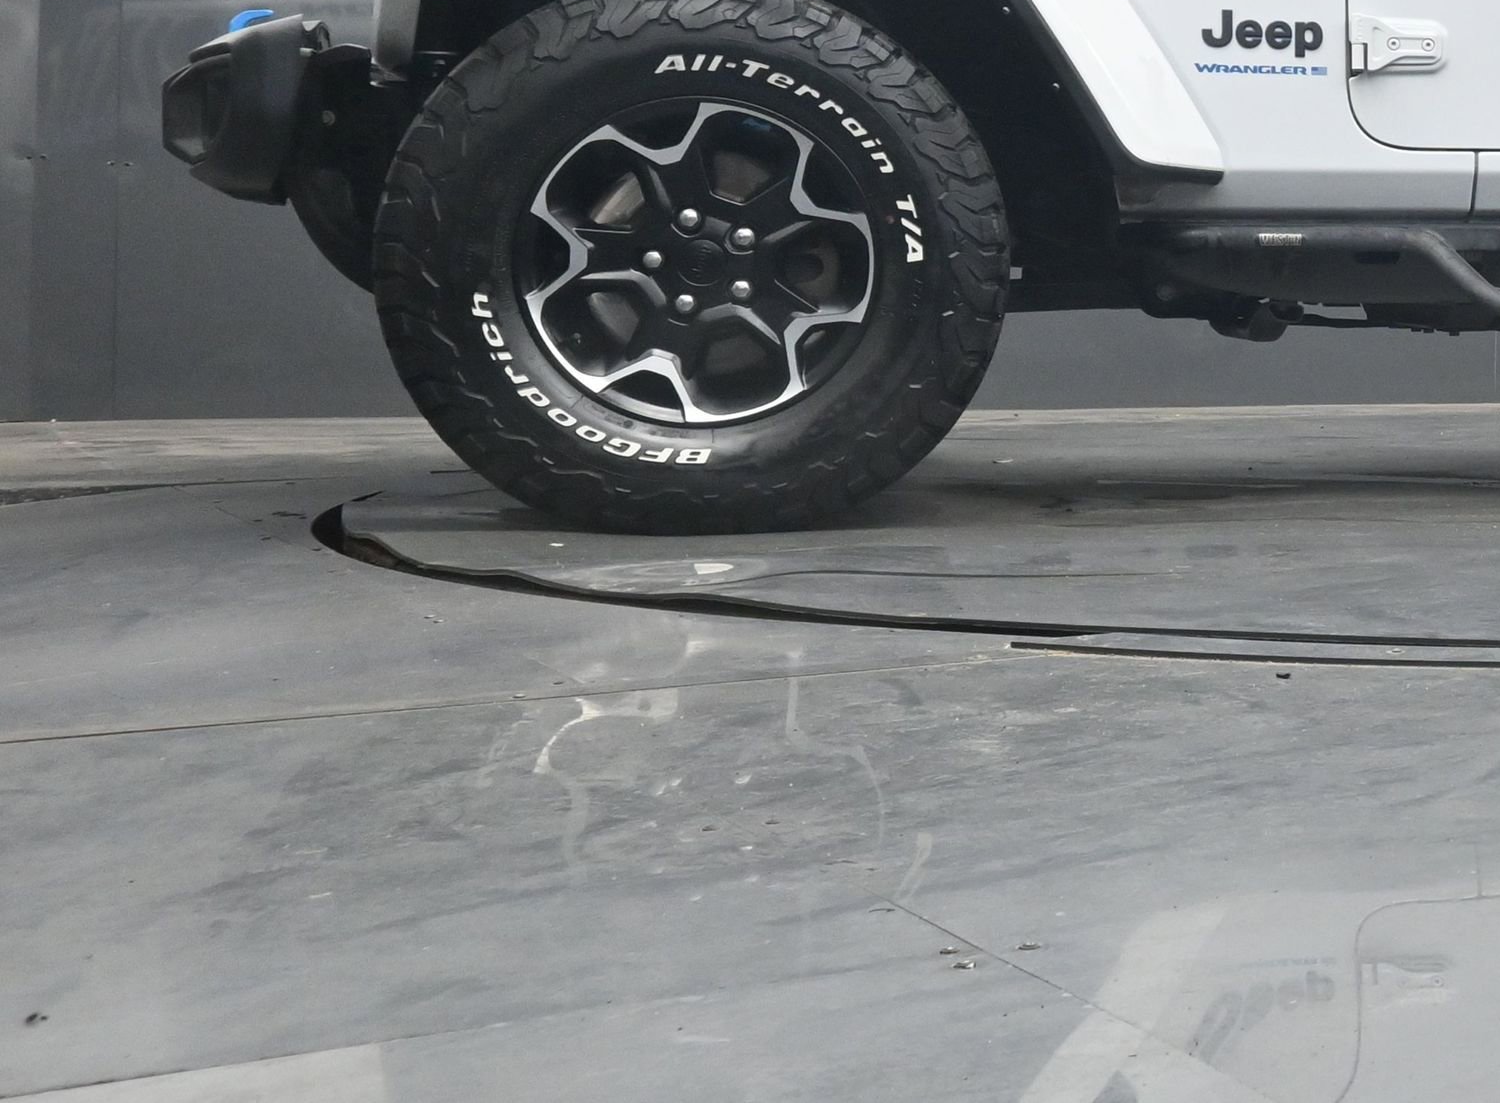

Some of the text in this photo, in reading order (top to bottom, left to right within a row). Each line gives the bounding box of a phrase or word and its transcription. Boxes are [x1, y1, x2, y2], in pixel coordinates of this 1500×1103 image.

[1193, 62, 1308, 76] WRANGLER
[1201, 9, 1324, 59] Jeep
[654, 53, 925, 264] All-Terrain T/A
[471, 292, 713, 465] BFGoodrich
